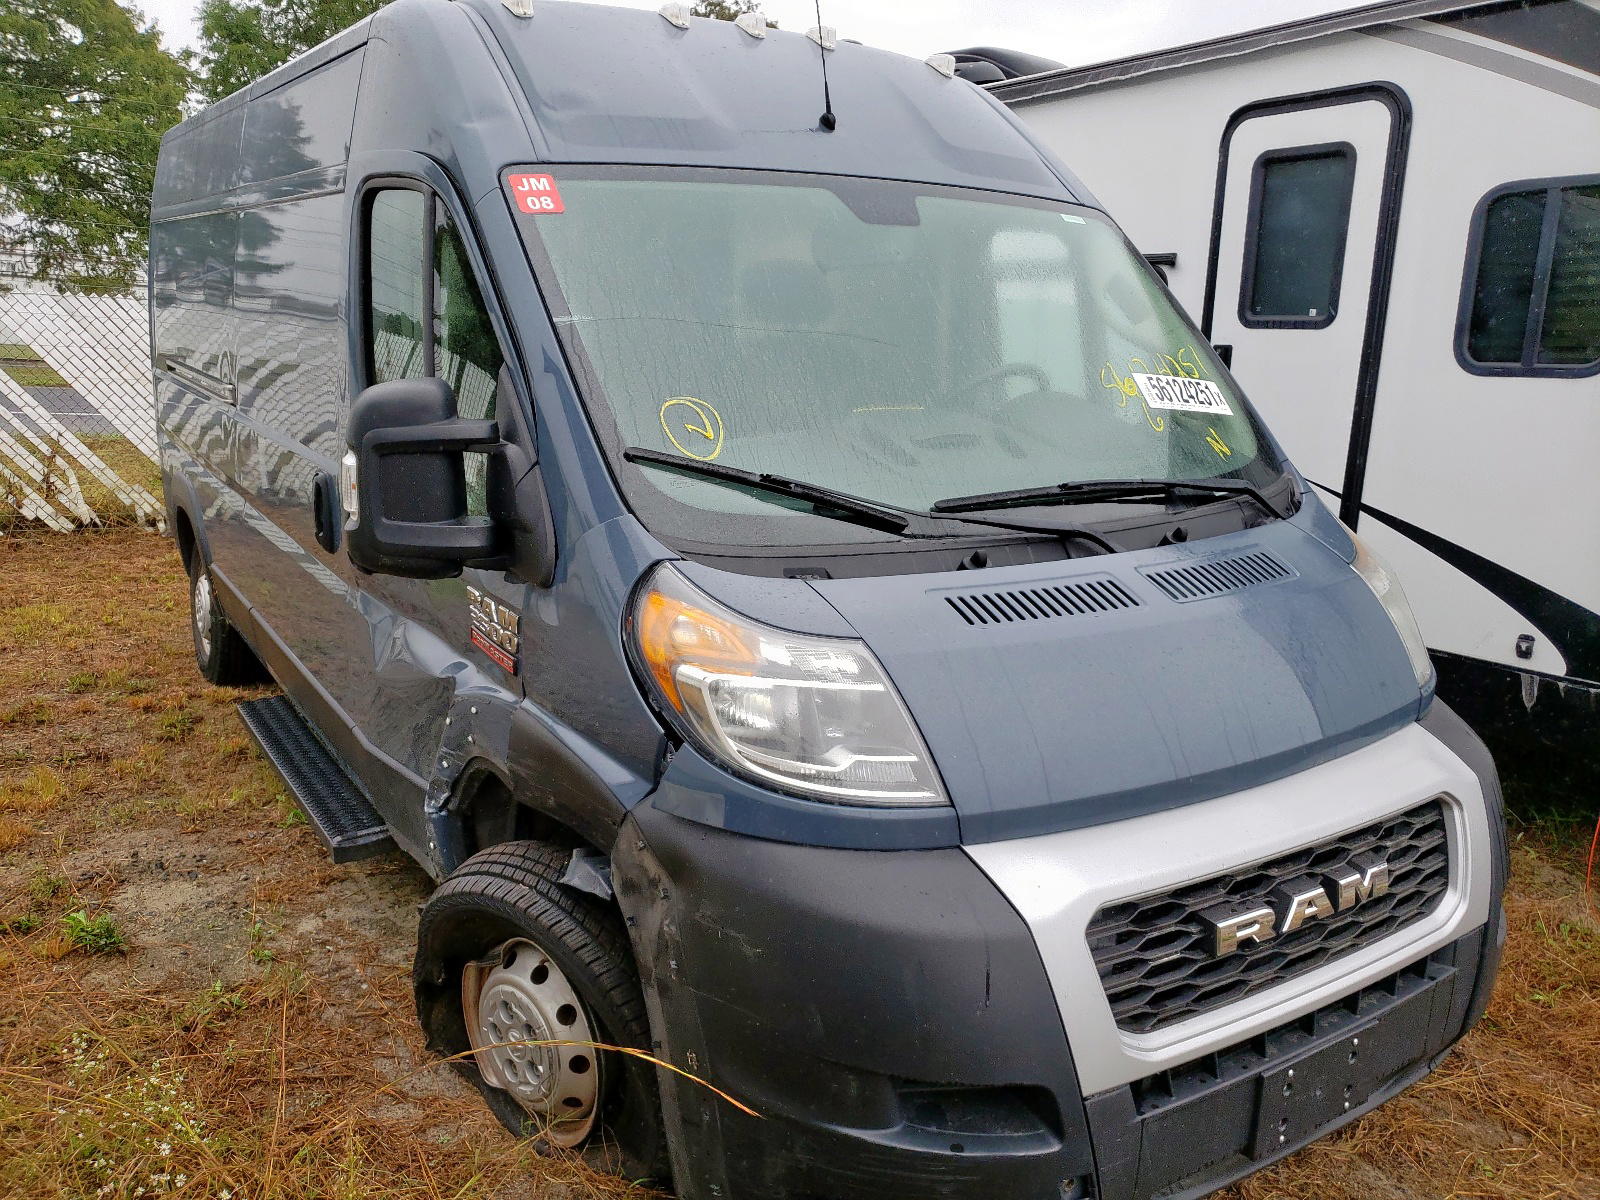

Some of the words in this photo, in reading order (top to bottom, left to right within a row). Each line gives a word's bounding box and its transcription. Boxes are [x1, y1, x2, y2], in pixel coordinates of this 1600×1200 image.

[517, 177, 551, 191] JM
[526, 196, 555, 210] 08
[1147, 376, 1219, 407] 56124251
[466, 585, 519, 635] RAM
[1214, 862, 1389, 957] RAM
